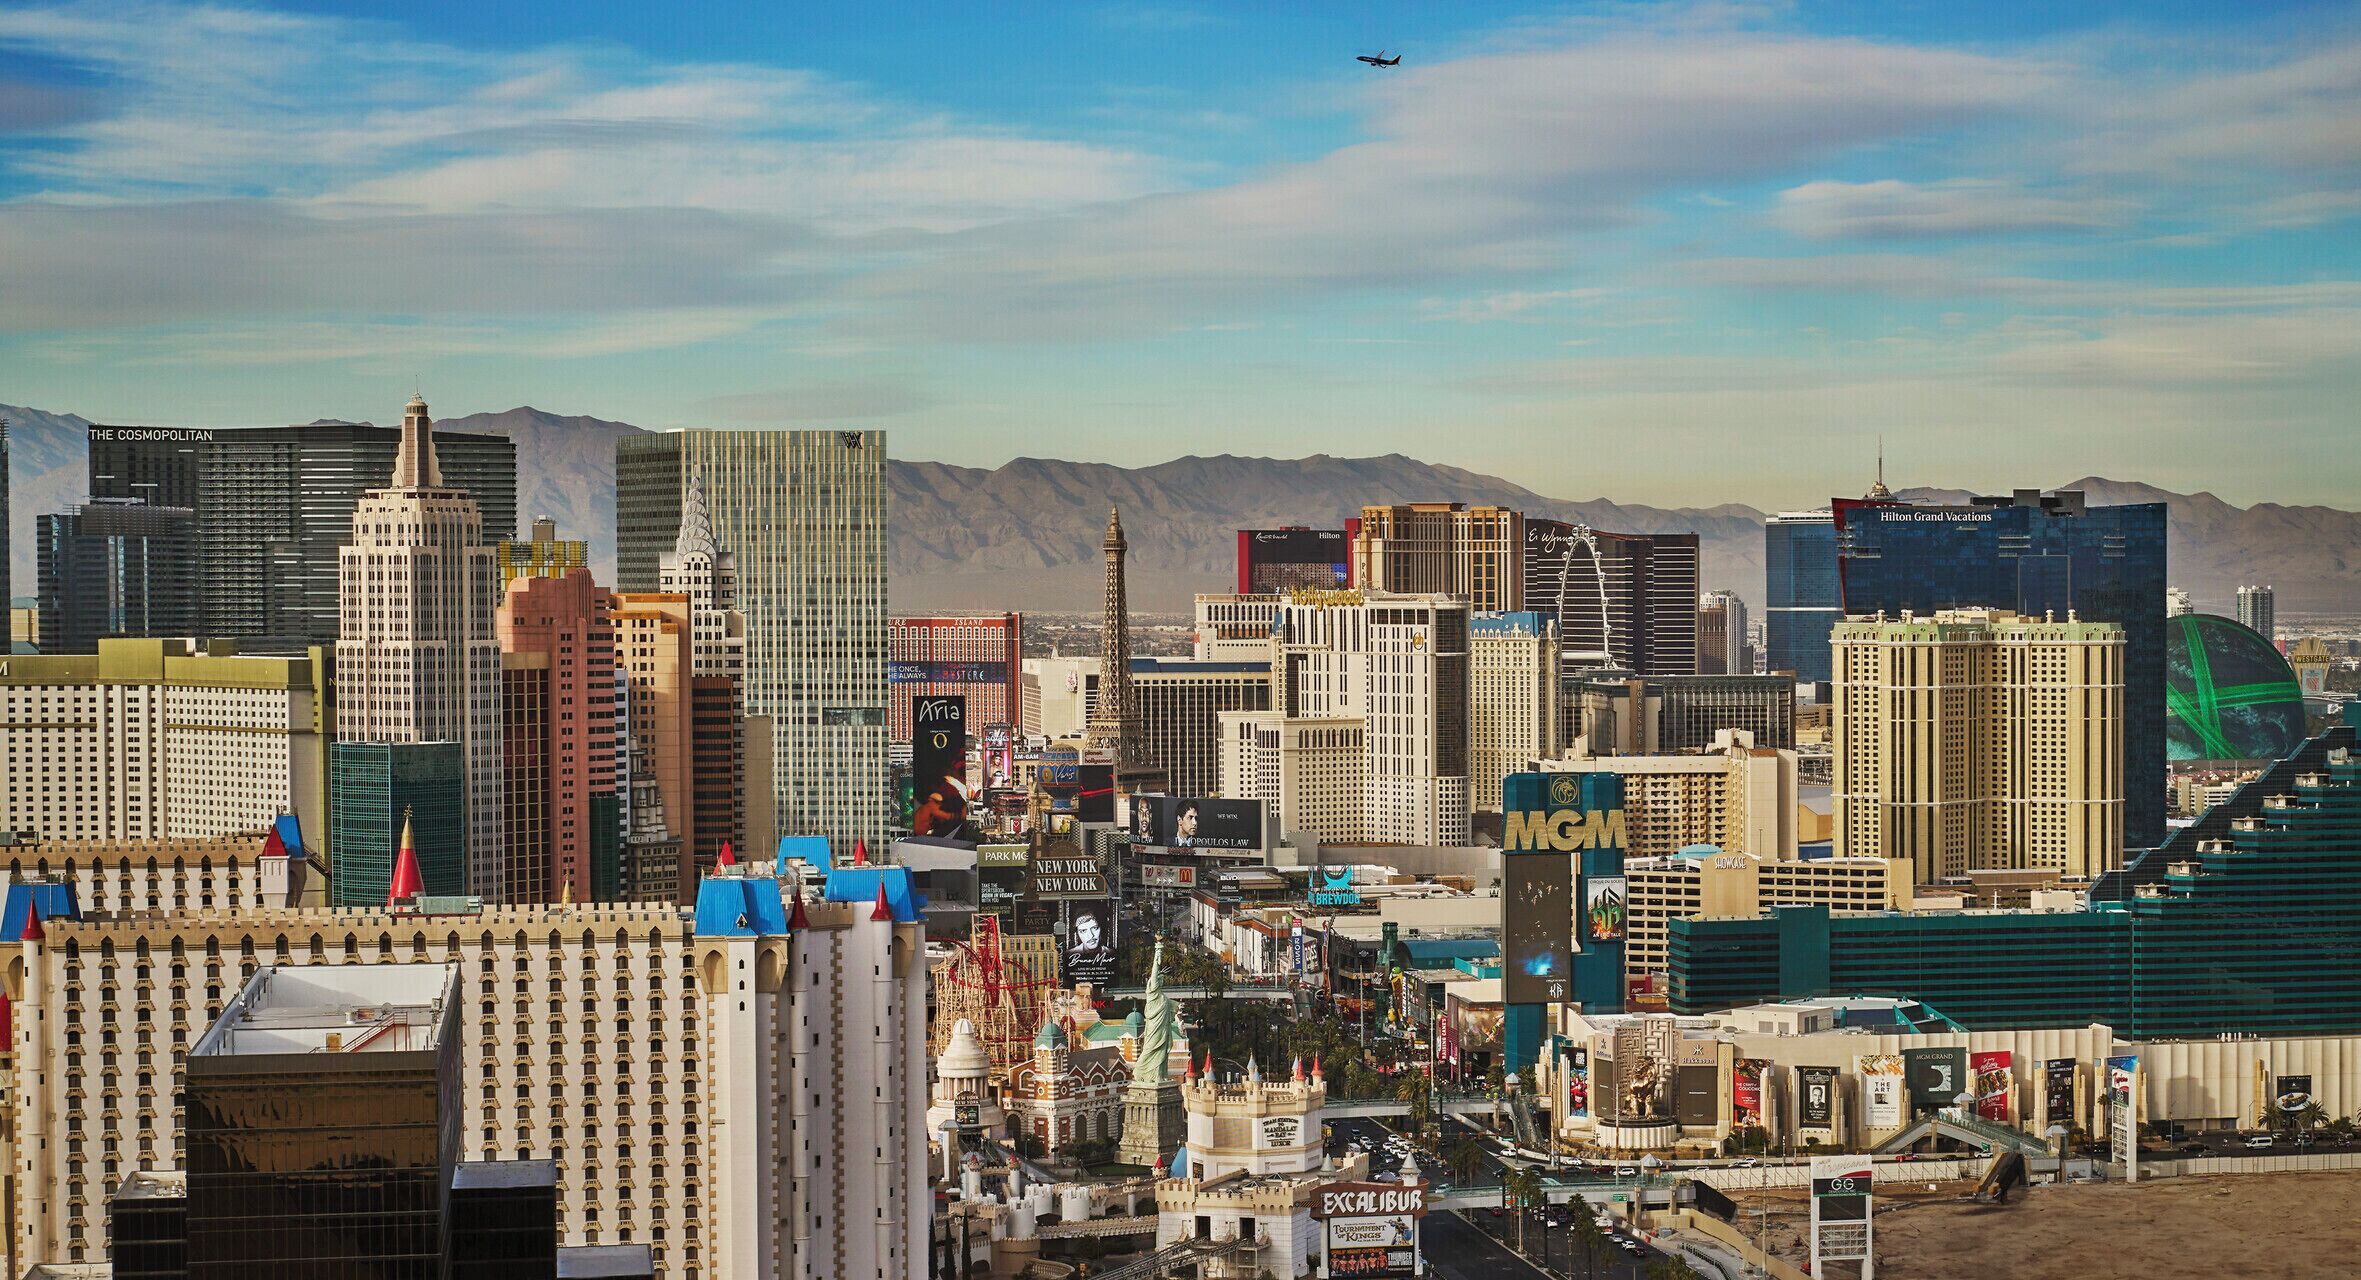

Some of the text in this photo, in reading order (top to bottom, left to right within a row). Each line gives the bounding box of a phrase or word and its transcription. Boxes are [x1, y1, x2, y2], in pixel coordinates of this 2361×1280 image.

[89, 429, 213, 442] THE COSMOPOLITAN
[1880, 511, 1992, 522] Hilton Grand Vacations
[1319, 532, 1341, 540] Hilton
[1290, 584, 1364, 612] hollywood
[2296, 655, 2329, 663] WESTGATE
[918, 699, 960, 722] Aria
[1503, 808, 1628, 851] MGM
[1231, 838, 1249, 846] LAW
[985, 851, 1011, 861] PARK
[1036, 859, 1098, 874] NEW YORK
[1715, 856, 1747, 870] SHOWCASE
[1036, 877, 1098, 892] NEW YORK
[1316, 892, 1361, 905] BREWDOG
[1931, 1053, 1954, 1061] GRAND
[1263, 1117, 1299, 1127] TRAM STATION
[1263, 1125, 1298, 1134] MANDALAY
[1831, 1178, 1854, 1191] GG
[1323, 1189, 1423, 1215] EXCALIBUR
[1333, 1224, 1387, 1235] TOURNAMENT
[1345, 1231, 1382, 1242] KINGS
[1387, 1251, 1413, 1261] THUNDER
